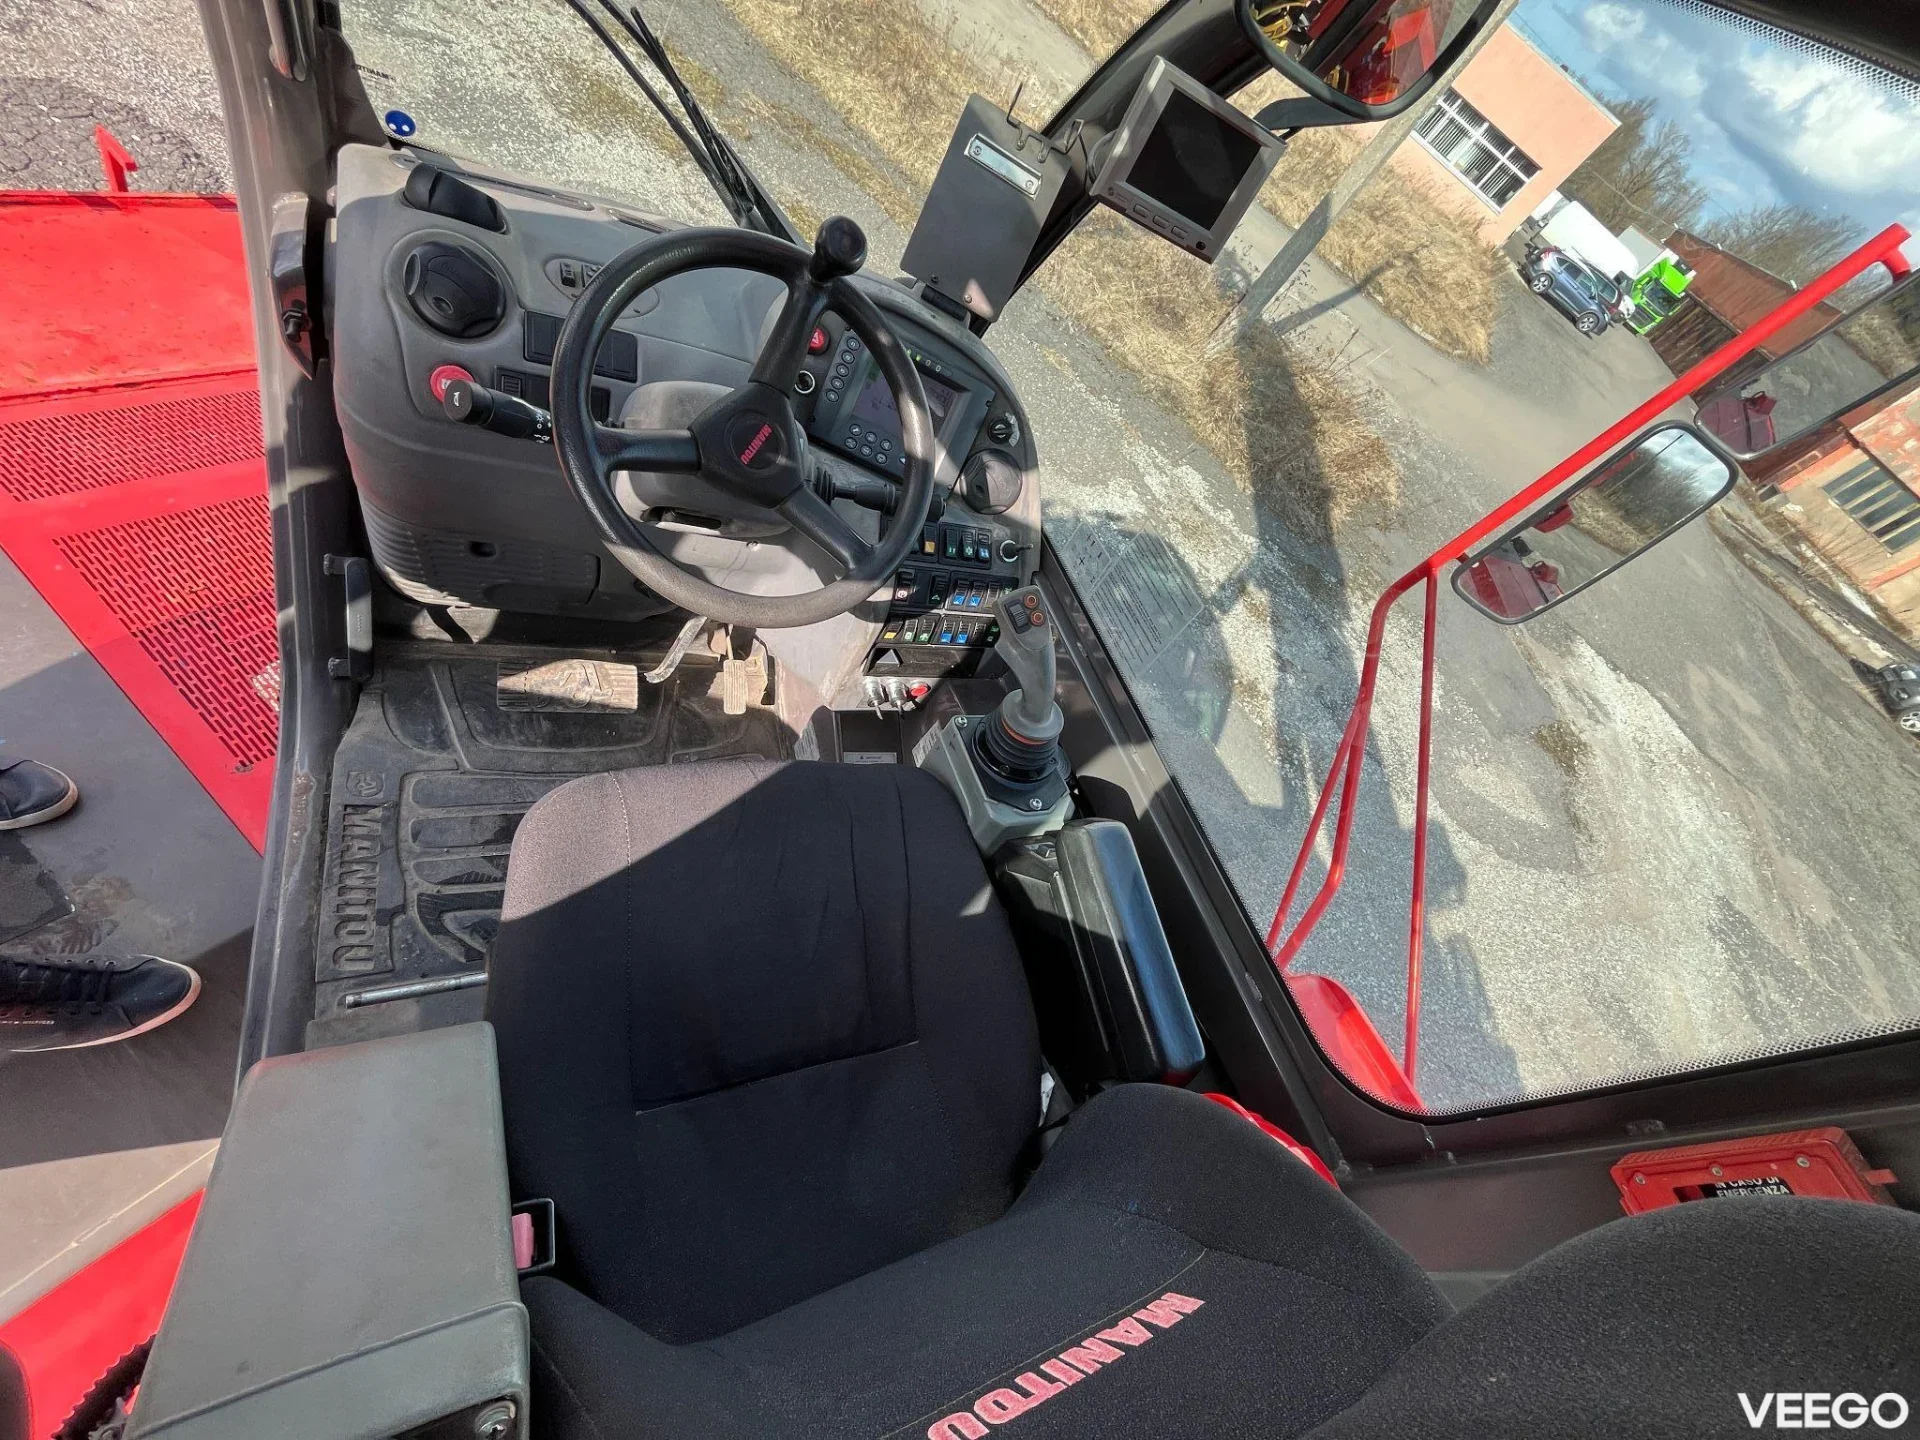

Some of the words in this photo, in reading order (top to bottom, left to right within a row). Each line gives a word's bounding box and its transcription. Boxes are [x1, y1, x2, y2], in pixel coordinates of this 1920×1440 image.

[740, 423, 773, 465] MANITOU
[332, 803, 384, 971] MANITOU
[1716, 1185, 1790, 1198] EMERGENZA
[927, 1291, 1206, 1440] MANITOU
